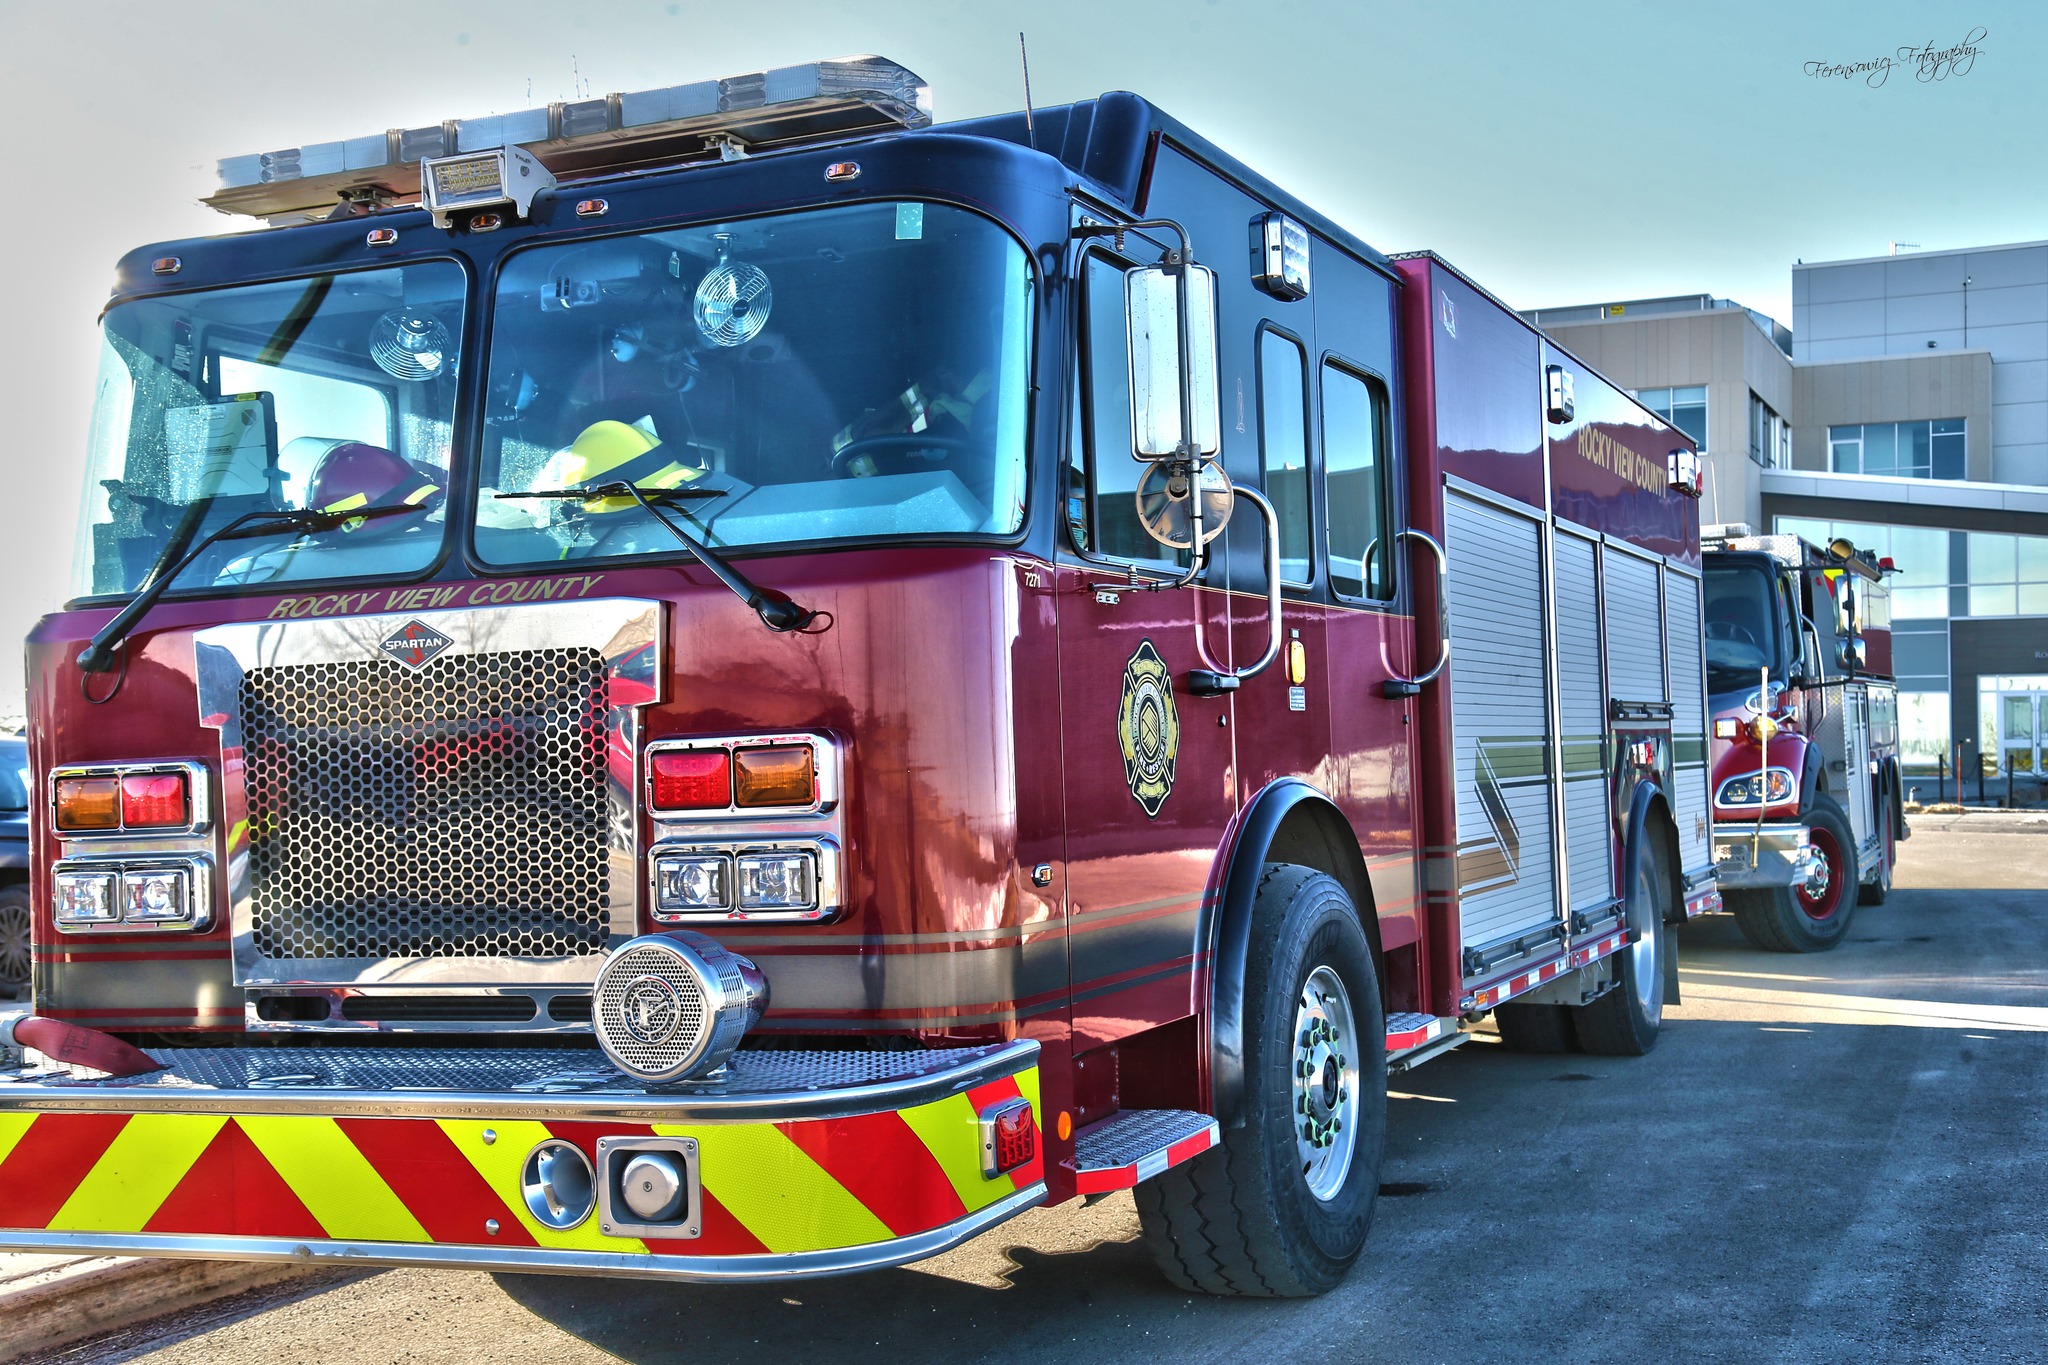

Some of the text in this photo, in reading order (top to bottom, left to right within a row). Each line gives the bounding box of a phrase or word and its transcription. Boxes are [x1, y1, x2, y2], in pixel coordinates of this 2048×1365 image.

[1578, 424, 1667, 499] ROCKY VIEW COUNTY
[1025, 572, 1041, 589] 7271
[267, 575, 605, 619] ROCKY VIEW COUNTY
[385, 637, 443, 651] SPARTAN
